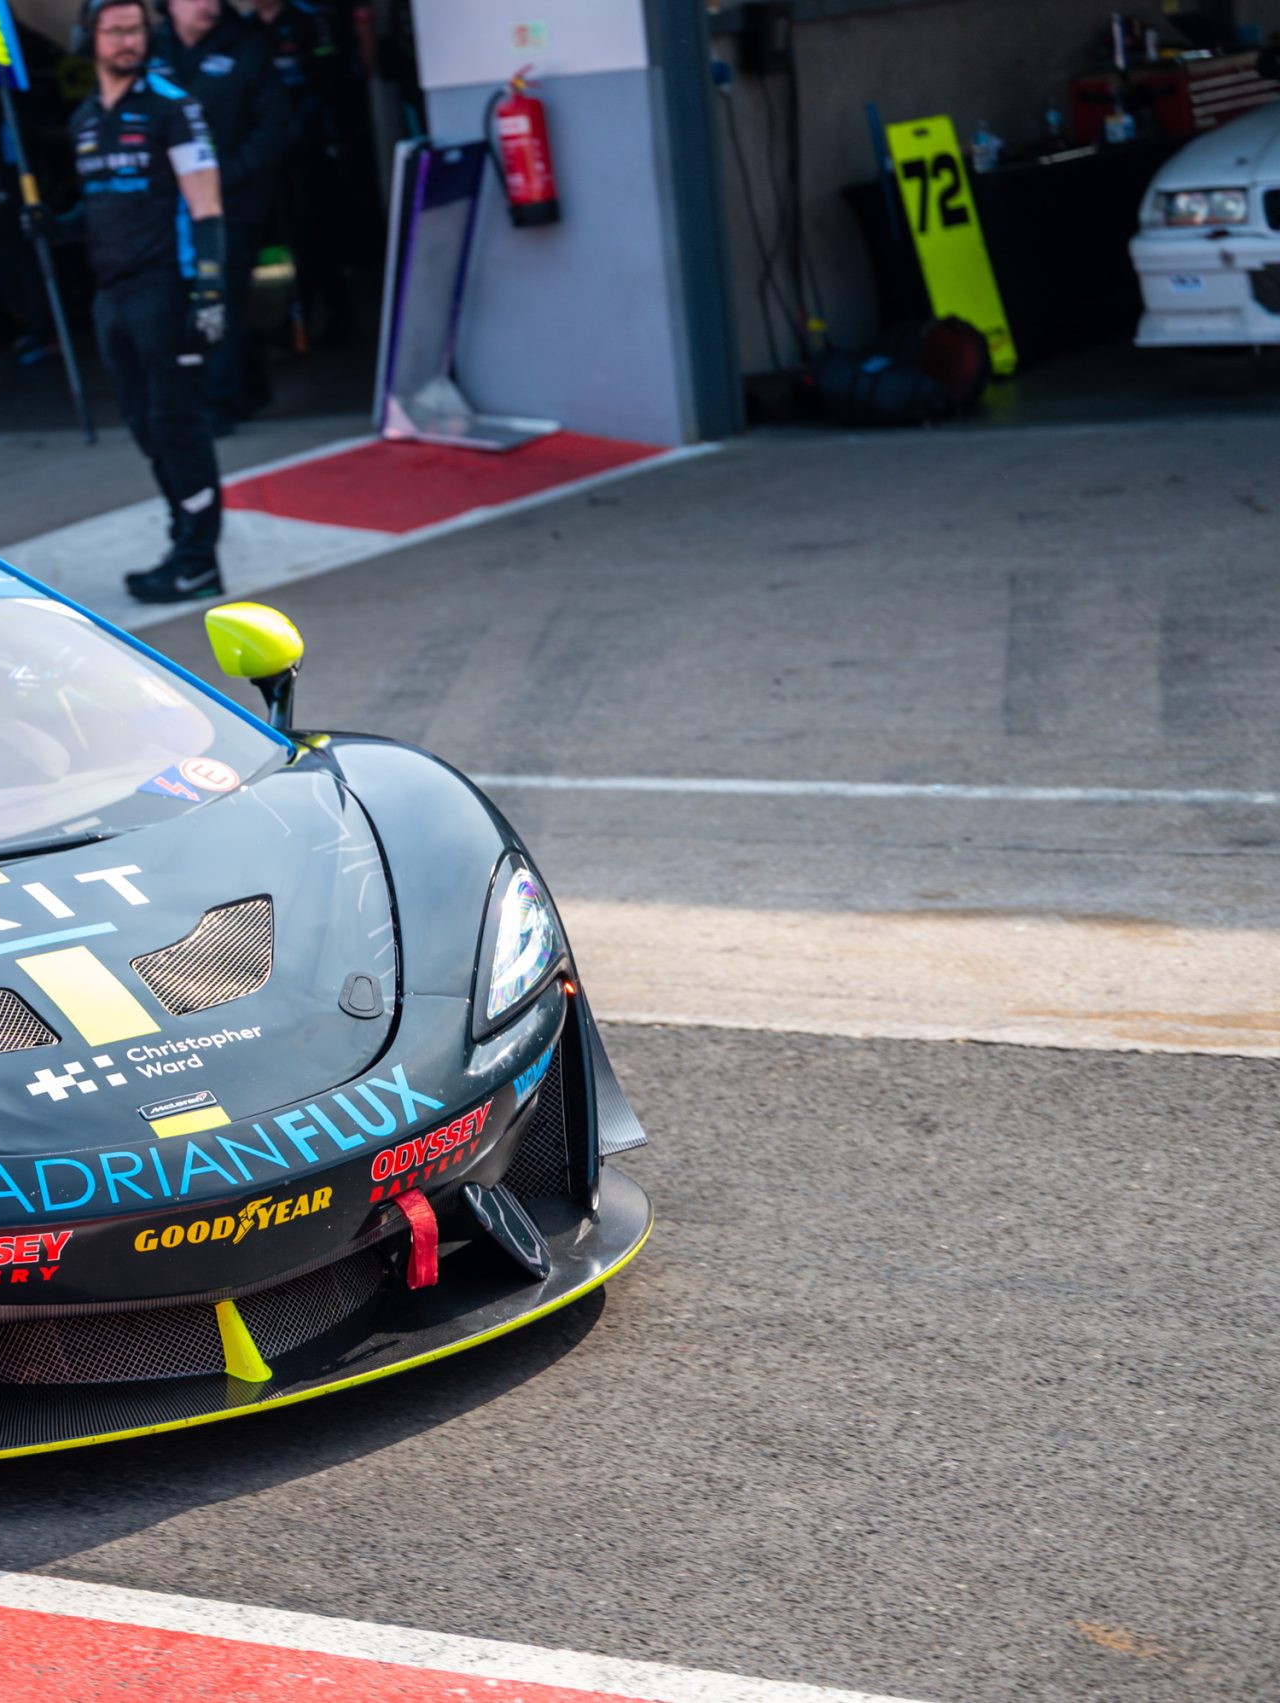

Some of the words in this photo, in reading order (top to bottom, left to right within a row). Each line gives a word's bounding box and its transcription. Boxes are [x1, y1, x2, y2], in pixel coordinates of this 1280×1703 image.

[901, 151, 970, 236] 72
[126, 1026, 262, 1063] Christopher
[135, 1053, 205, 1080] Ward
[369, 1139, 480, 1204] BATTERY
[370, 1100, 494, 1183] ODYSSEY
[133, 1186, 334, 1253] GOODYEAR
